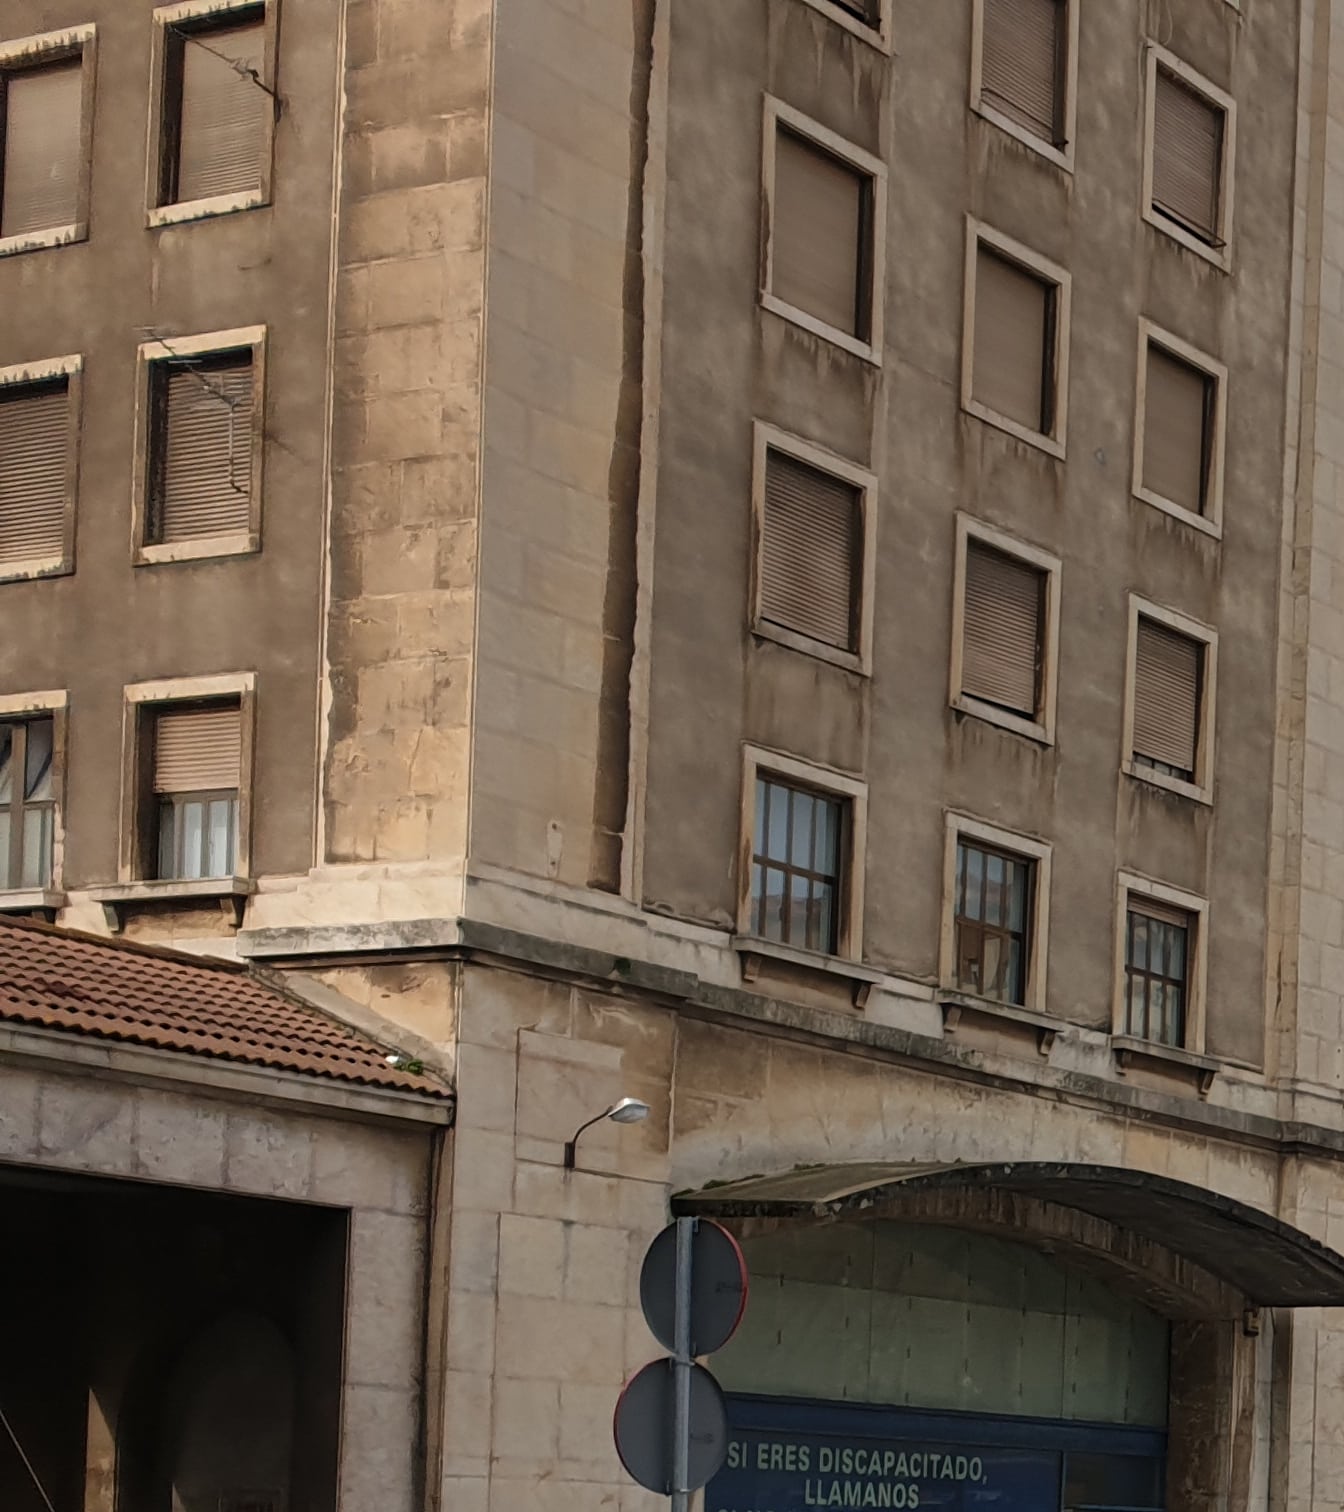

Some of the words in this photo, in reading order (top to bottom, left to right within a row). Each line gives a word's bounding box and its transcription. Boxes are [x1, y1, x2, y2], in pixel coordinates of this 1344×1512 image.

[727, 1441, 747, 1468] SI
[757, 1443, 810, 1471] ERES
[819, 1447, 988, 1485] DISCAPACITADO,
[804, 1479, 920, 1509] LLAMANOS
